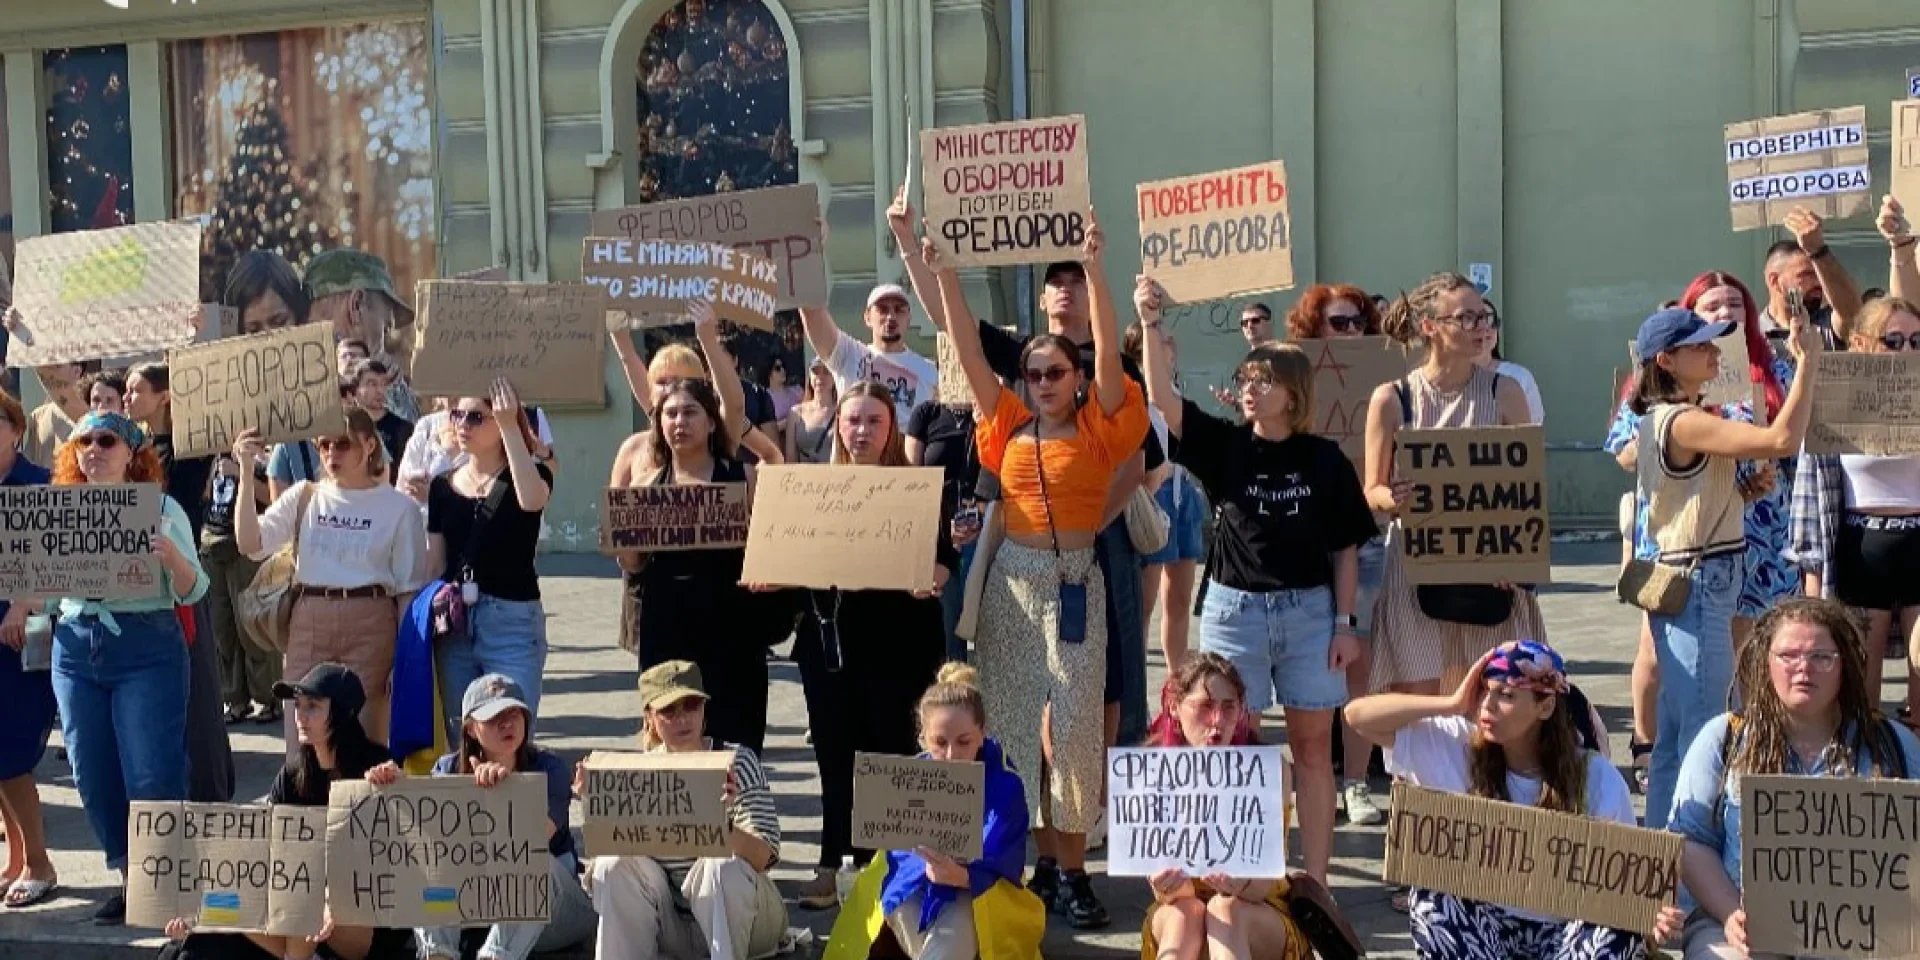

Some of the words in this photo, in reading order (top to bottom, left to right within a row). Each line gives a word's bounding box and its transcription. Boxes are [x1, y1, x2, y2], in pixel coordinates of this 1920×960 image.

[936, 122, 1078, 162] МІНІСТЕРСТВУ
[1729, 127, 1861, 159] ПОВЕРНІТЬ
[943, 160, 1064, 194] ОБОРОНИ
[1733, 170, 1866, 199] ФЕДОРОВА
[618, 200, 747, 239] ФЕДОРОВ
[959, 191, 1053, 216] ПОТРІБЕН
[942, 212, 1085, 254] ФЕДОРОВ
[1143, 212, 1288, 268] ФЕДОРОВА
[593, 240, 633, 263] НЕ
[741, 255, 777, 283] ТИХ
[171, 341, 329, 410] ФЕДОРОВ
[1404, 442, 1454, 468] ТА
[1469, 441, 1527, 467] ШО
[608, 489, 628, 506] НЕ
[1409, 484, 1433, 512] З
[1443, 481, 1541, 512] ВАМИ
[11, 538, 32, 554] НЕ
[1404, 526, 1444, 557] НЕ
[1451, 517, 1543, 555] ТАК?
[588, 770, 686, 794] ПОЯСНІТЬ
[1113, 751, 1266, 791] ФЕДОРОВА
[590, 792, 695, 816] ПРИЧИНУ
[1114, 794, 1218, 825] ПОВЕРНИ
[1231, 795, 1266, 825] НА
[1754, 789, 1920, 841] РЕЗУЛЬТАТ
[1129, 825, 1264, 867] ПОСАДУ!!!
[142, 855, 310, 894] ФЕДОРОВА
[1548, 835, 1678, 903] ФЕДОРОВА
[1752, 846, 1910, 891] ПОТРЕБУЄ
[353, 870, 396, 912] НЕ
[1790, 900, 1876, 951] ЧАСУ
